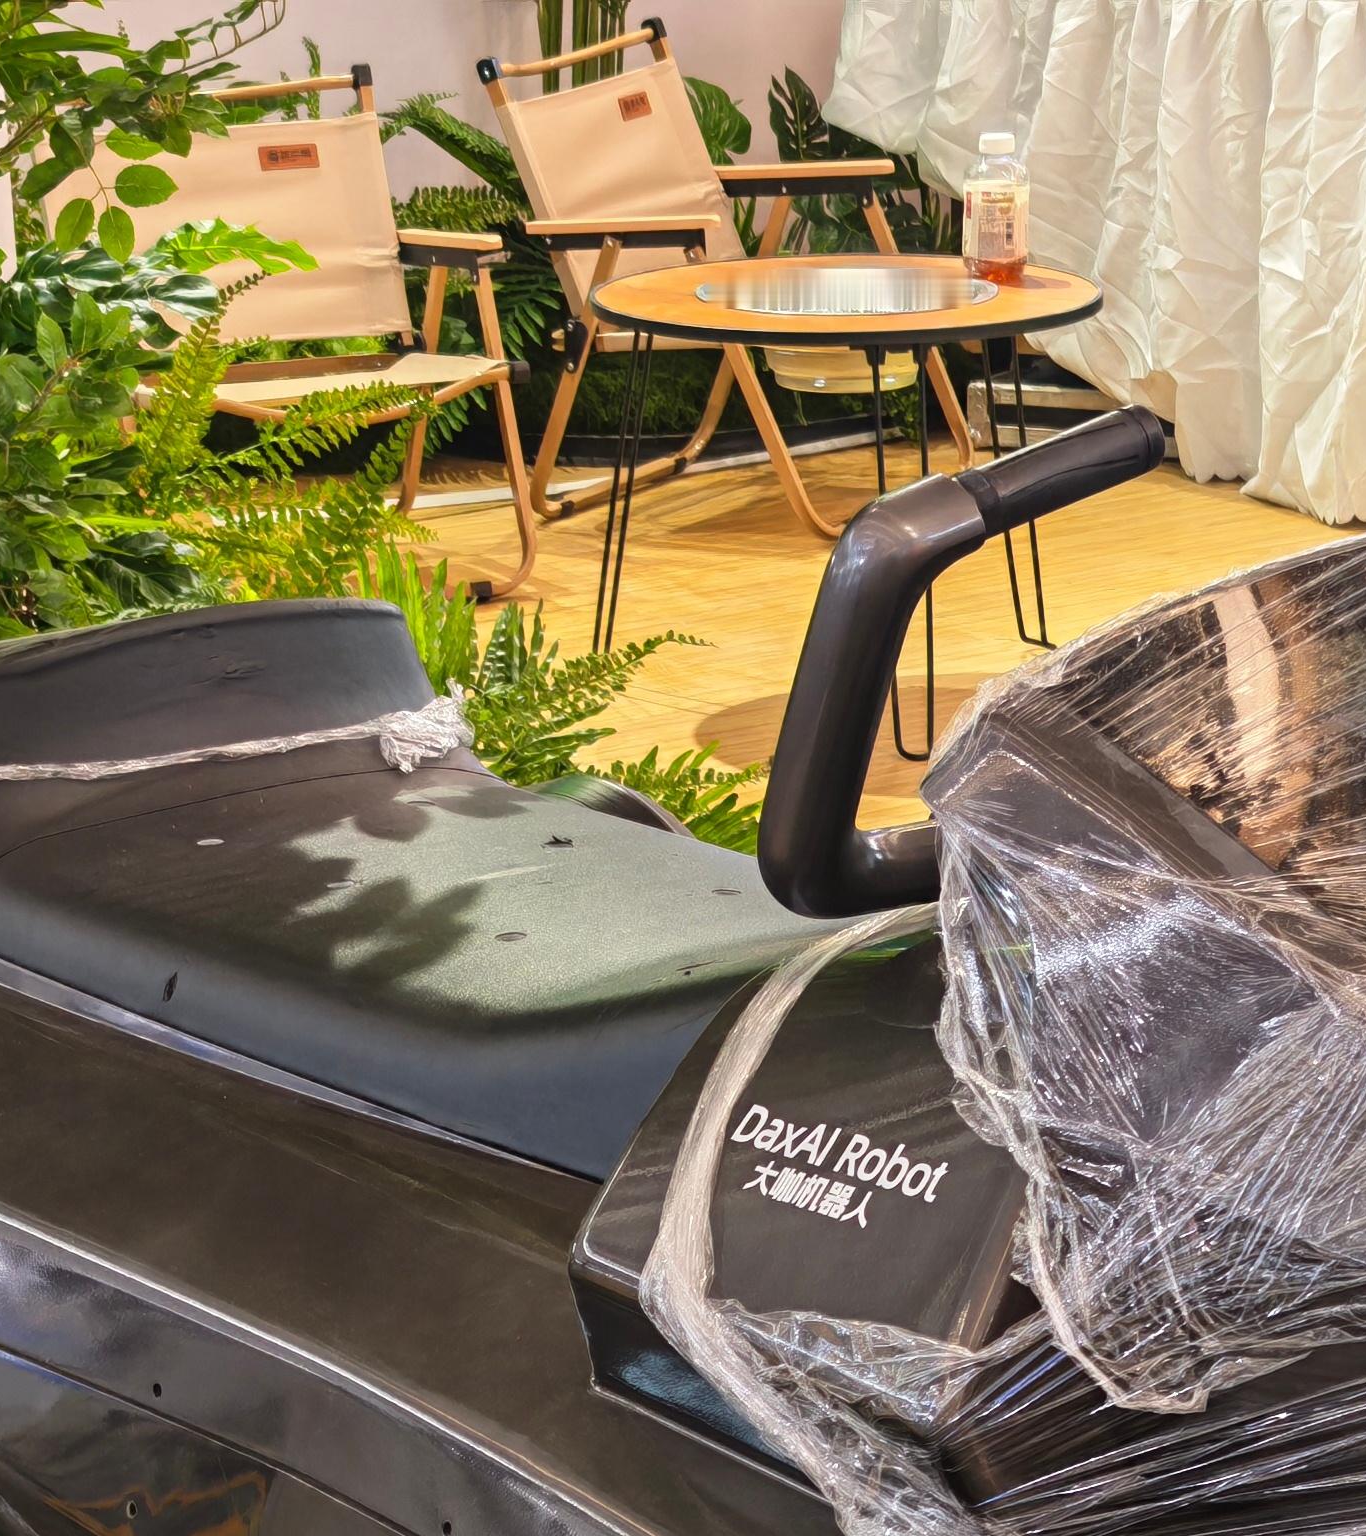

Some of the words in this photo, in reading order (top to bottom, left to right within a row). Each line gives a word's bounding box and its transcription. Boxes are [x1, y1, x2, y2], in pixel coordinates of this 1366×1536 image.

[731, 1104, 842, 1166] DaxAI
[833, 1133, 949, 1203] Robot
[742, 1160, 873, 1229] 大咖机器人
